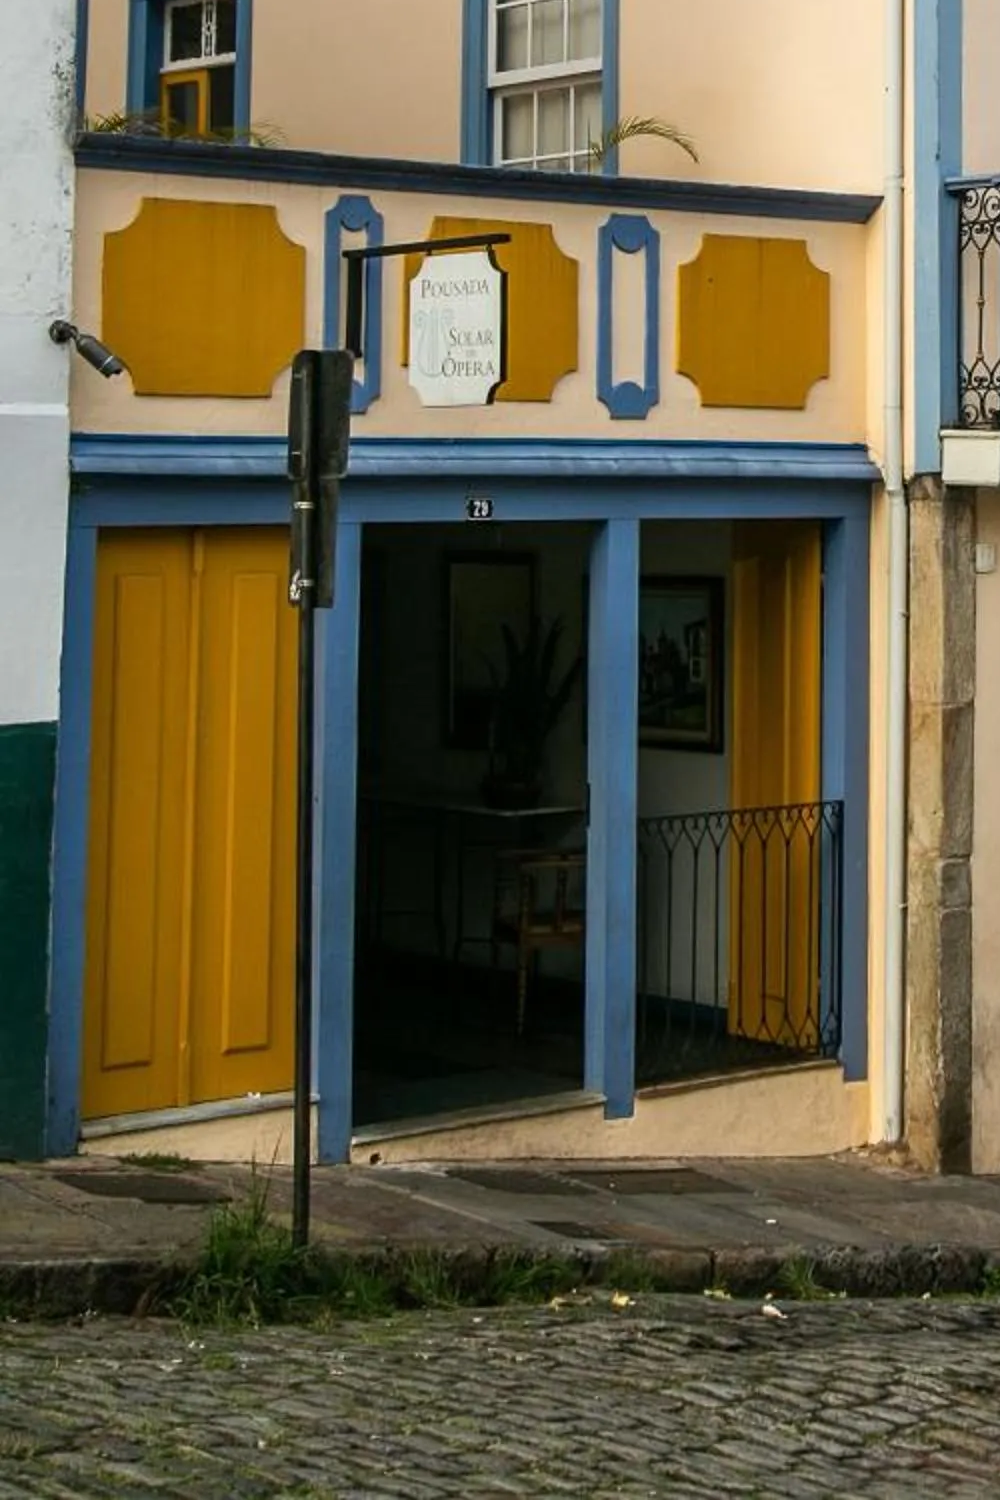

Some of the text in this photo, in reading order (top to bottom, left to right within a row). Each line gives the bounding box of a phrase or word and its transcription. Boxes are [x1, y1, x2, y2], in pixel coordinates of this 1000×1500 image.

[421, 279, 489, 299] POUSADA
[449, 326, 493, 347] SOLAR
[441, 351, 495, 378] ÓPERA
